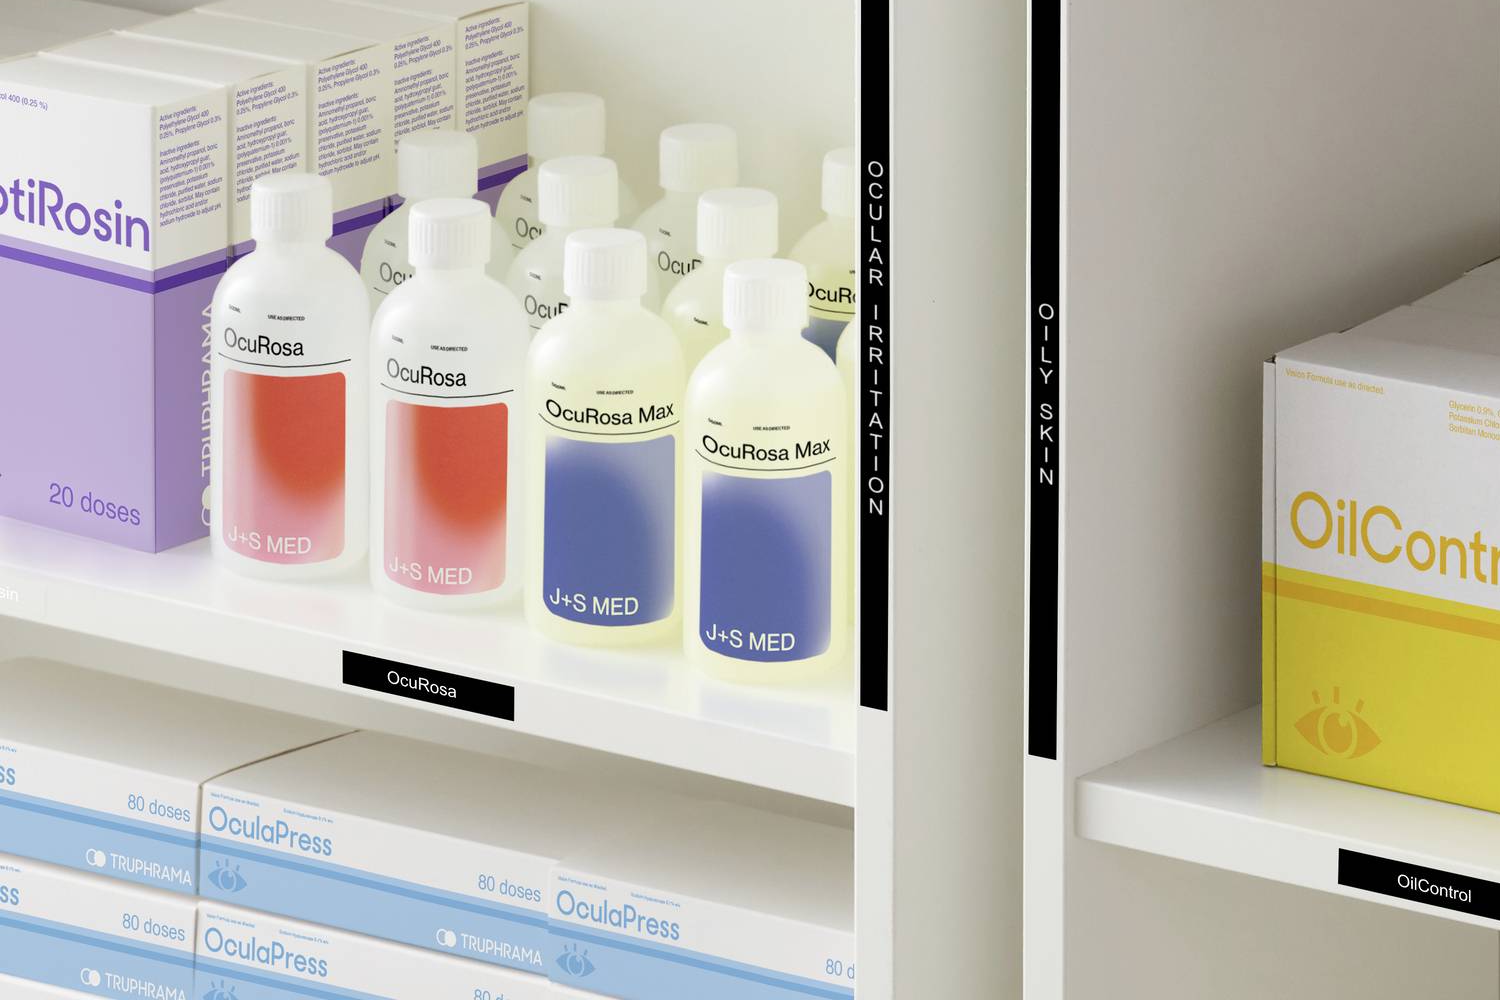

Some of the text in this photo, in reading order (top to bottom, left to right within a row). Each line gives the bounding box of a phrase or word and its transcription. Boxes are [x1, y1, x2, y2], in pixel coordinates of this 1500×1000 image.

[8, 92, 21, 105] 400
[223, 327, 305, 358] OcuRosa
[867, 160, 884, 516] OCULAR IRRITATION
[386, 358, 467, 387] OcuRosa
[1038, 303, 1054, 486] OILY SKIN
[545, 399, 674, 425] OcuRosa Max
[702, 434, 831, 462] OcuRosa Max
[49, 482, 141, 527] 20 doses
[228, 525, 312, 555] J+S MED
[388, 556, 473, 585] J+S MED
[549, 587, 639, 616] J+S MED
[705, 623, 796, 652] J+S MED
[386, 669, 458, 699] OcuRosa
[127, 793, 191, 823] 80 doses
[208, 806, 333, 857] OculaPress
[110, 853, 192, 887] TRUPHRAMA
[477, 873, 496, 892] 80
[499, 879, 541, 903] doses
[1396, 873, 1472, 904] OilControl
[122, 912, 140, 931] 80
[143, 917, 185, 942] doses
[556, 889, 680, 941] OculaPress
[204, 926, 328, 978] OculaPress
[461, 933, 543, 967] TRUPHRAMA
[105, 972, 187, 1000] TRUPHRAMA
